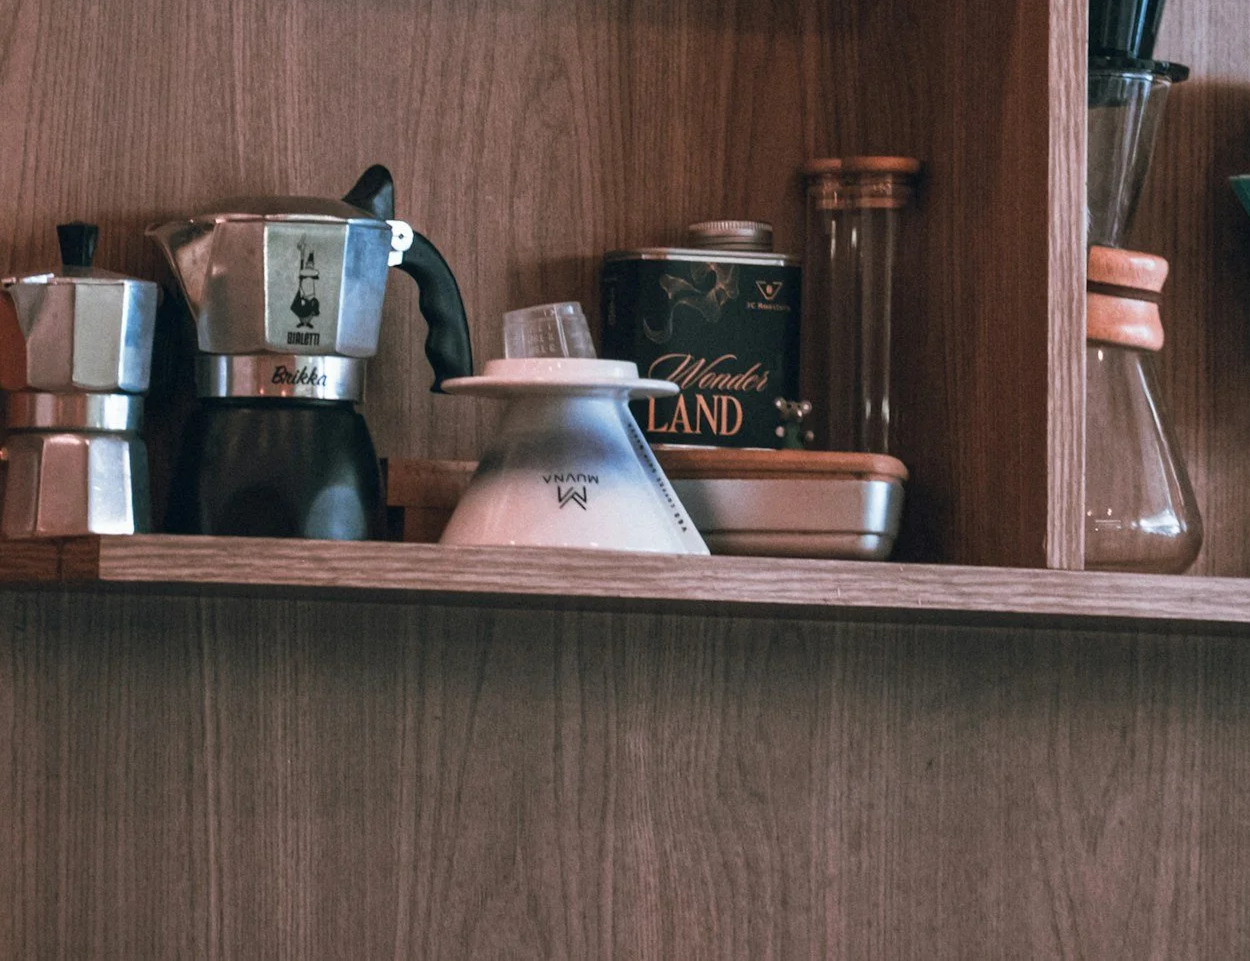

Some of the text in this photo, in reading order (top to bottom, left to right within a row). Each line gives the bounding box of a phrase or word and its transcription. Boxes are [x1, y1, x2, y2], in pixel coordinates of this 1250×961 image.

[271, 365, 327, 387] Brikka
[648, 353, 769, 391] Wonder
[647, 394, 743, 435] LAND
